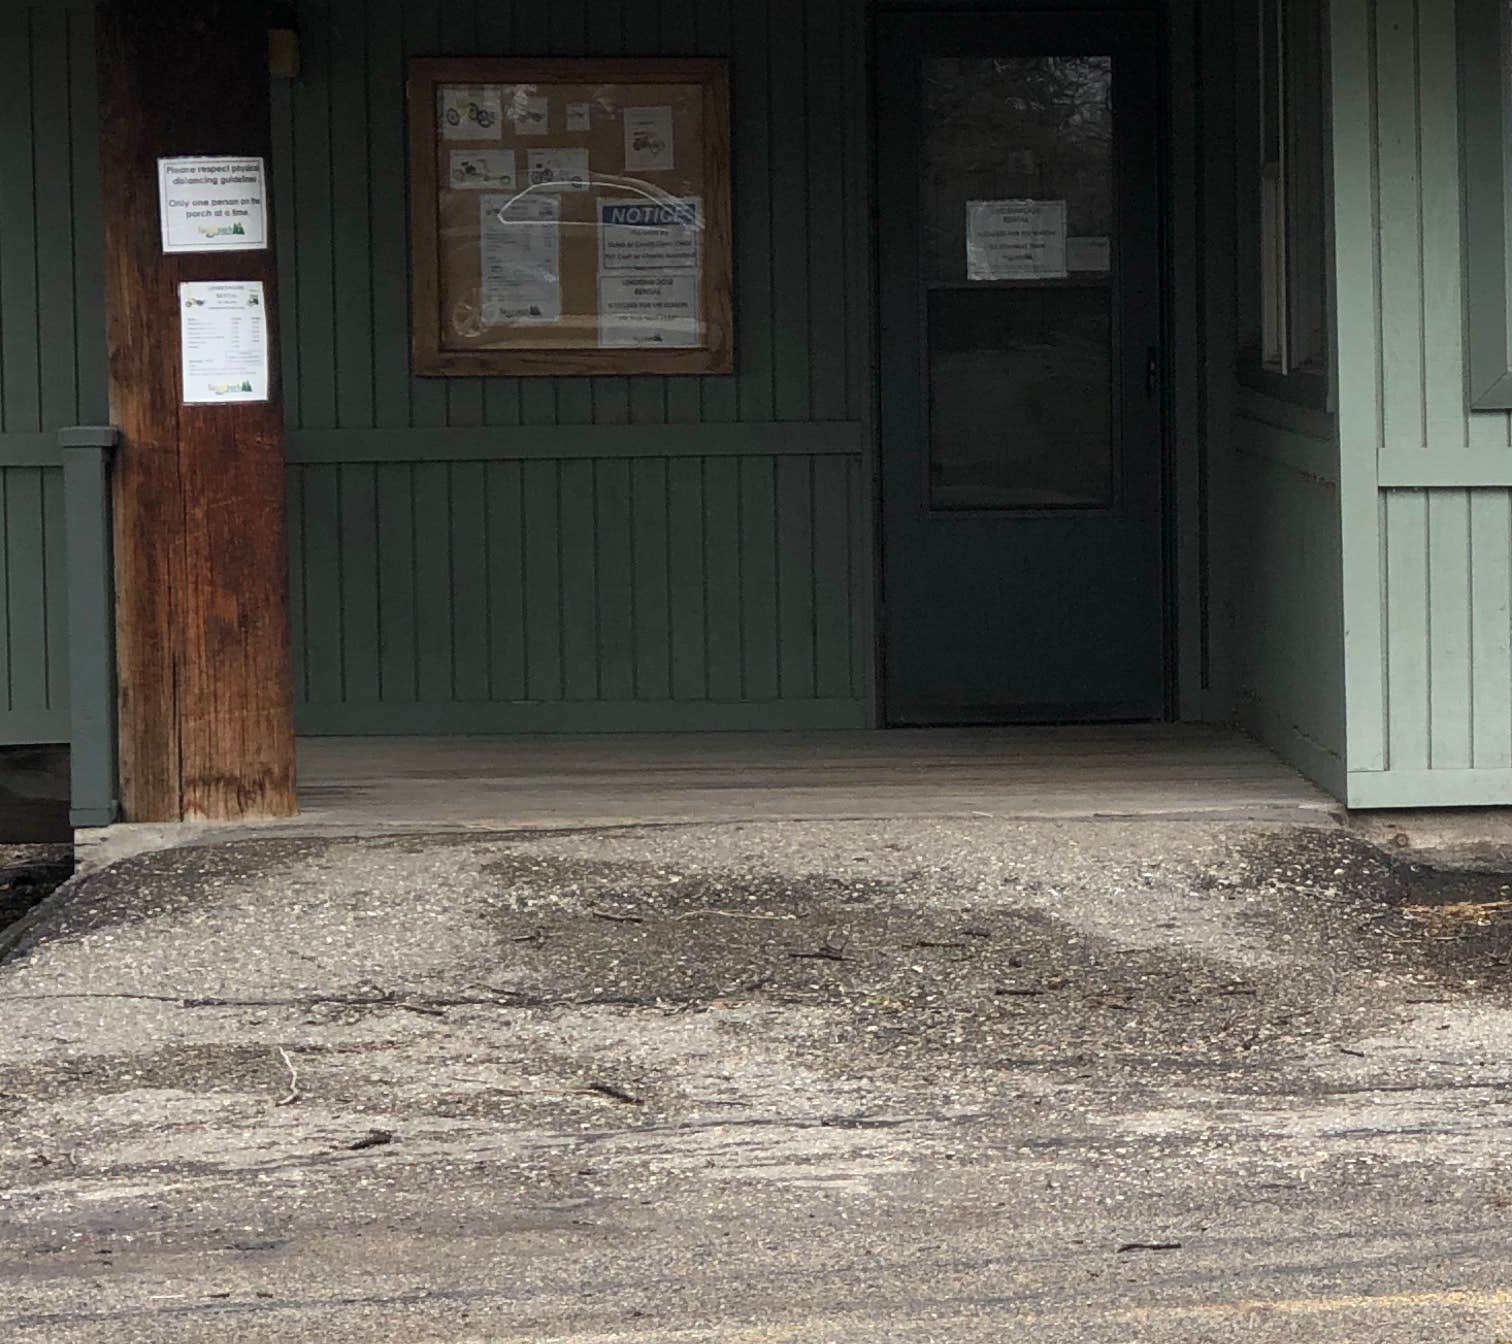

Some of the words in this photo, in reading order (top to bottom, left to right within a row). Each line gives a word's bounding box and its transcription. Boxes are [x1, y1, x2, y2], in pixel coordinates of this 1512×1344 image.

[166, 166, 195, 174] Please
[197, 164, 229, 174] respect
[172, 176, 218, 185] distancing
[168, 199, 190, 208] Only
[211, 199, 239, 207] person
[186, 209, 212, 219] porch
[214, 209, 223, 217] at
